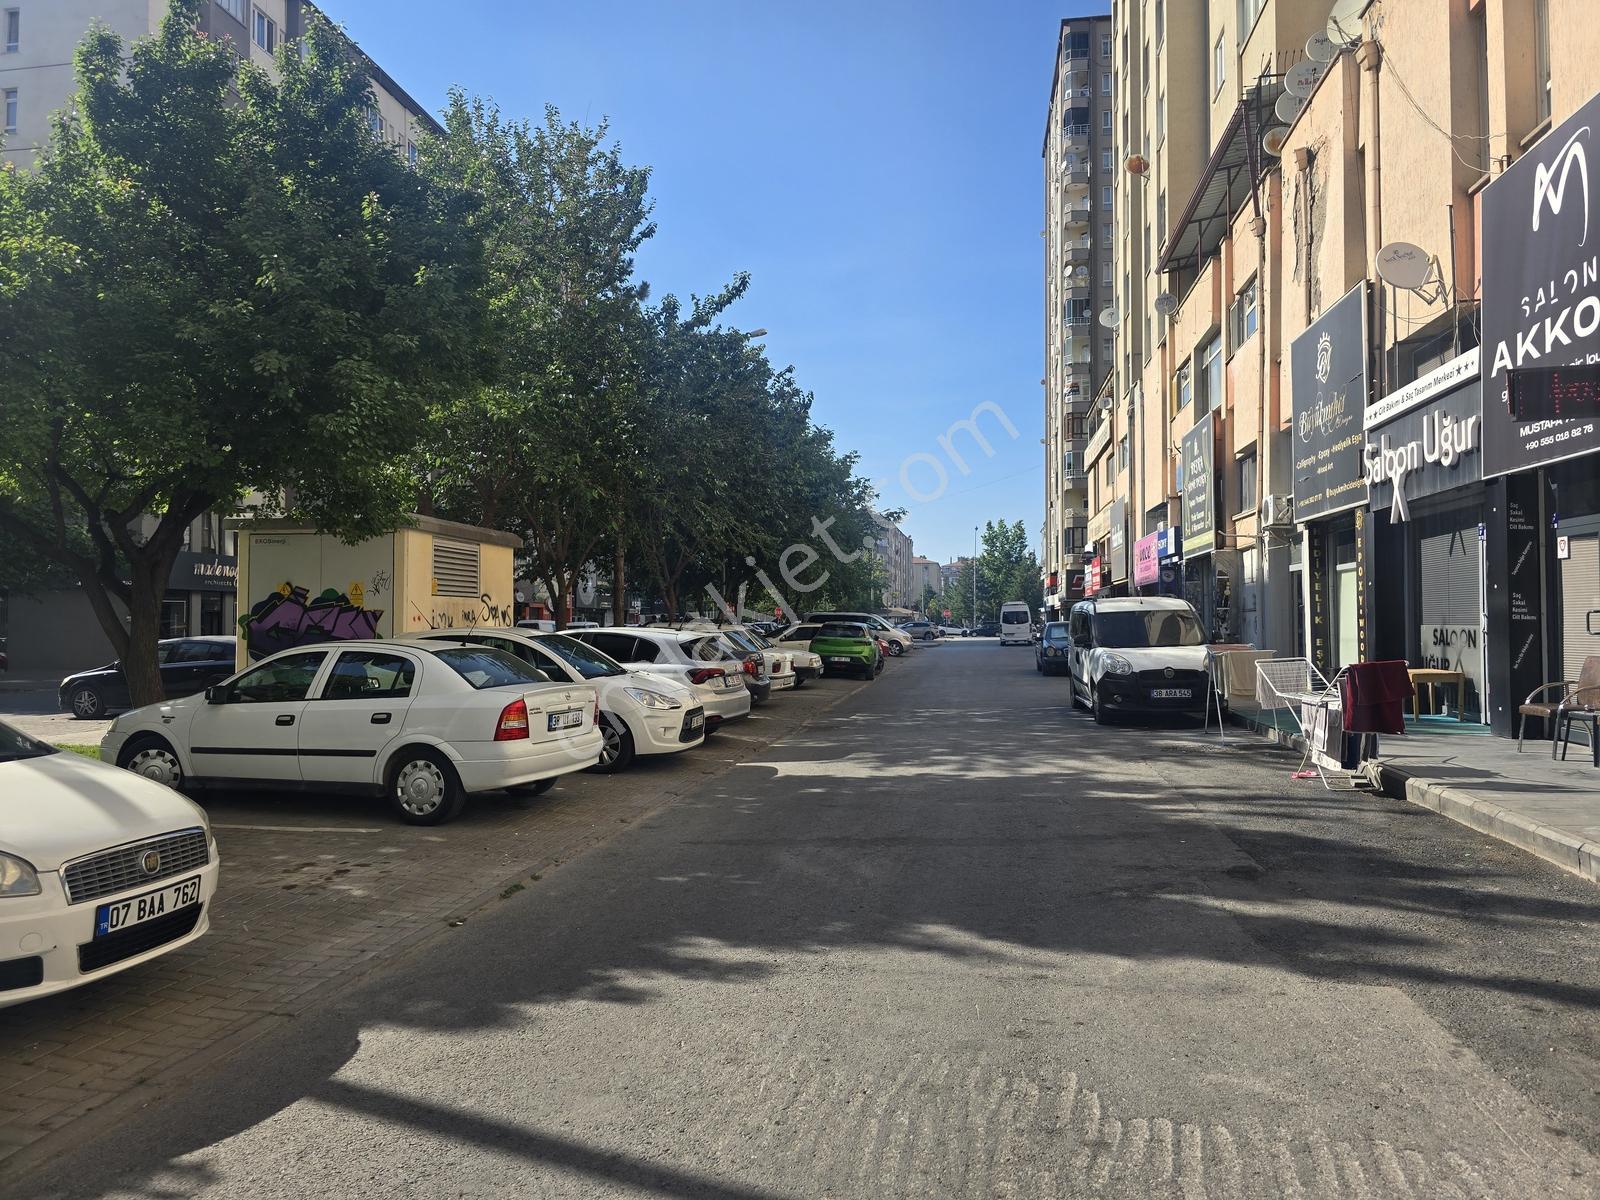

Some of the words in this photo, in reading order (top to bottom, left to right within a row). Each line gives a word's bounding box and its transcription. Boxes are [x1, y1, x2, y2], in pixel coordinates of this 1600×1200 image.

[1521, 256, 1597, 318] SALON
[1414, 382, 1433, 397] Tasarım
[1433, 368, 1455, 386] Merkezi
[1423, 410, 1480, 466] Uğur
[1525, 440, 1539, 450] +90
[1540, 436, 1554, 446] 555
[1555, 431, 1570, 441] 018
[1571, 427, 1582, 437] 82
[1583, 424, 1593, 435] 78
[1316, 638, 1324, 669] EŞY
[110, 902, 131, 929] 07
[137, 893, 164, 921] BAA
[173, 881, 197, 908] 762
